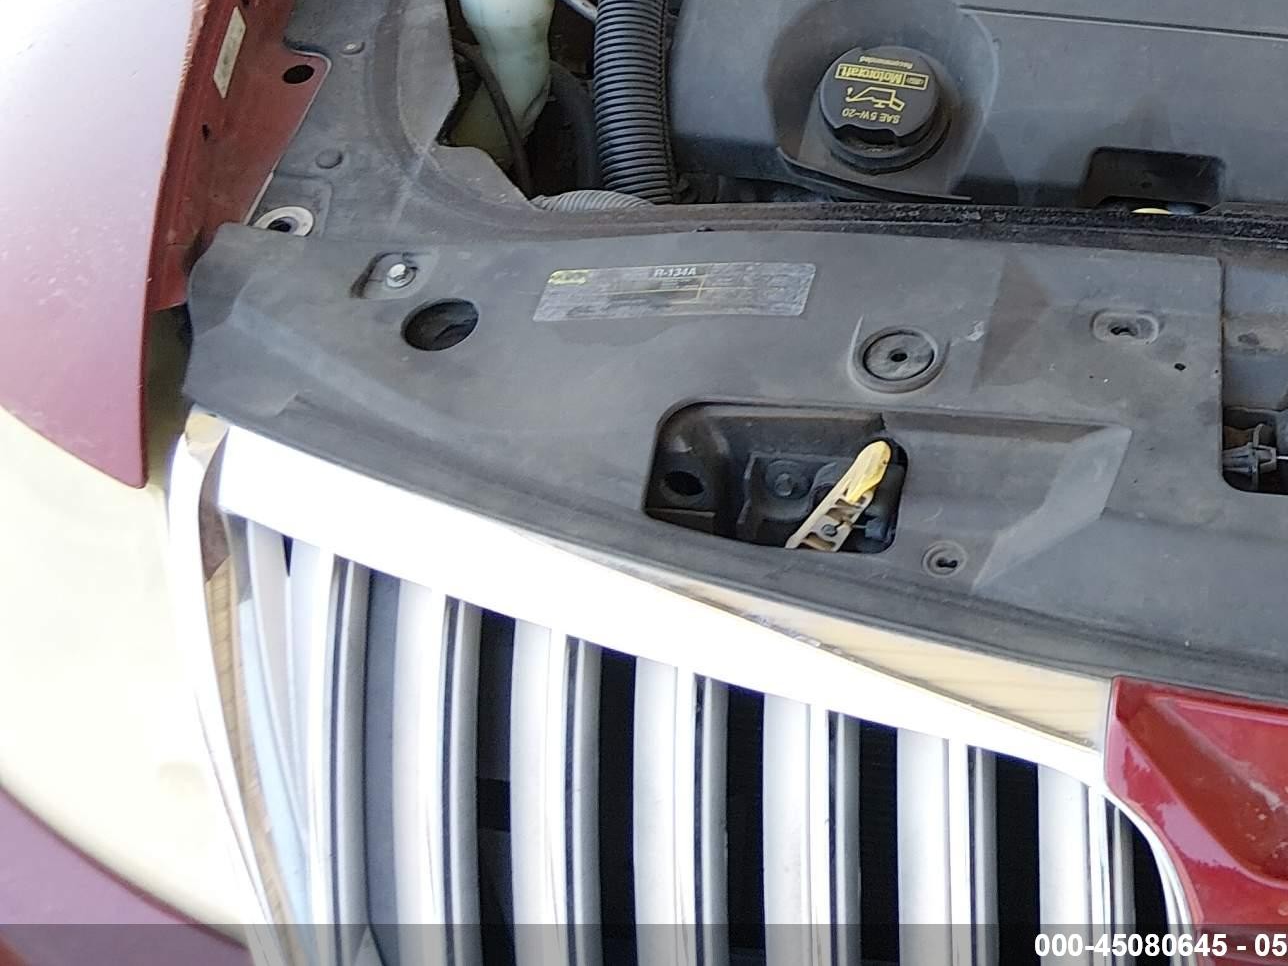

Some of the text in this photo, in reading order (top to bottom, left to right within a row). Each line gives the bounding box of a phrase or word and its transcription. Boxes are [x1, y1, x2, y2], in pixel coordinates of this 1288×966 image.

[841, 66, 903, 84] Motorcraft
[842, 108, 901, 124] SAE 5W-20
[653, 266, 698, 277] R-134A
